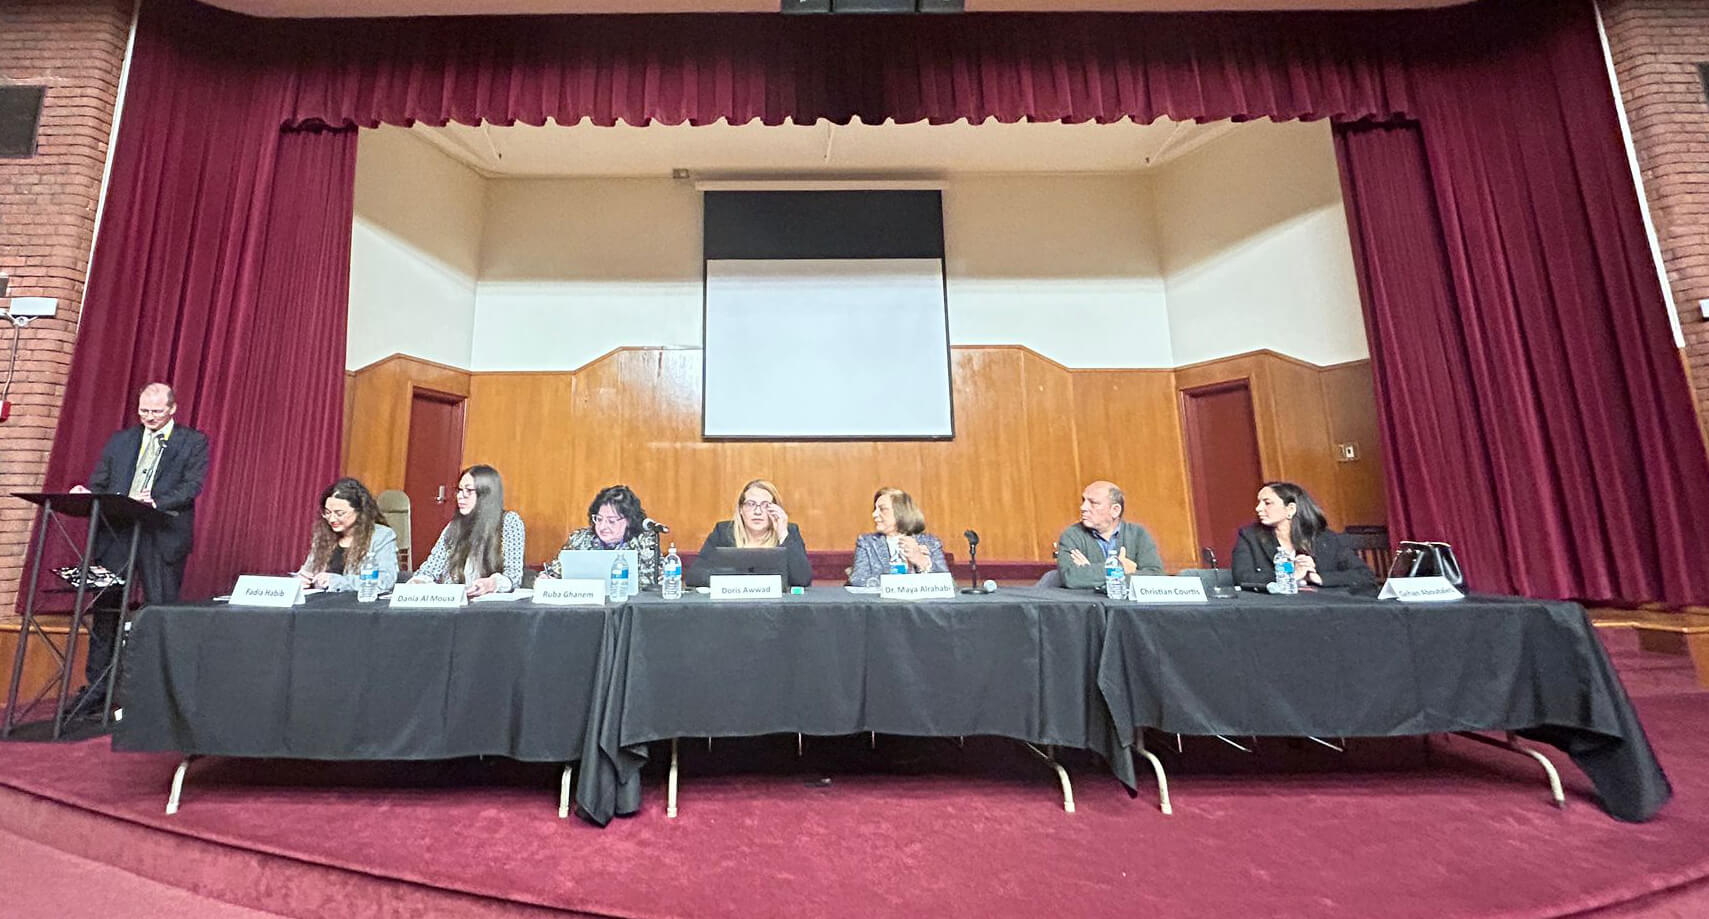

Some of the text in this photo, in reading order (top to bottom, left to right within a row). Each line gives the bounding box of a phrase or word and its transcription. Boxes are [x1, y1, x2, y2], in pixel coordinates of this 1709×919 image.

[246, 588, 284, 597] Fadia Habib
[898, 586, 918, 594] Maya
